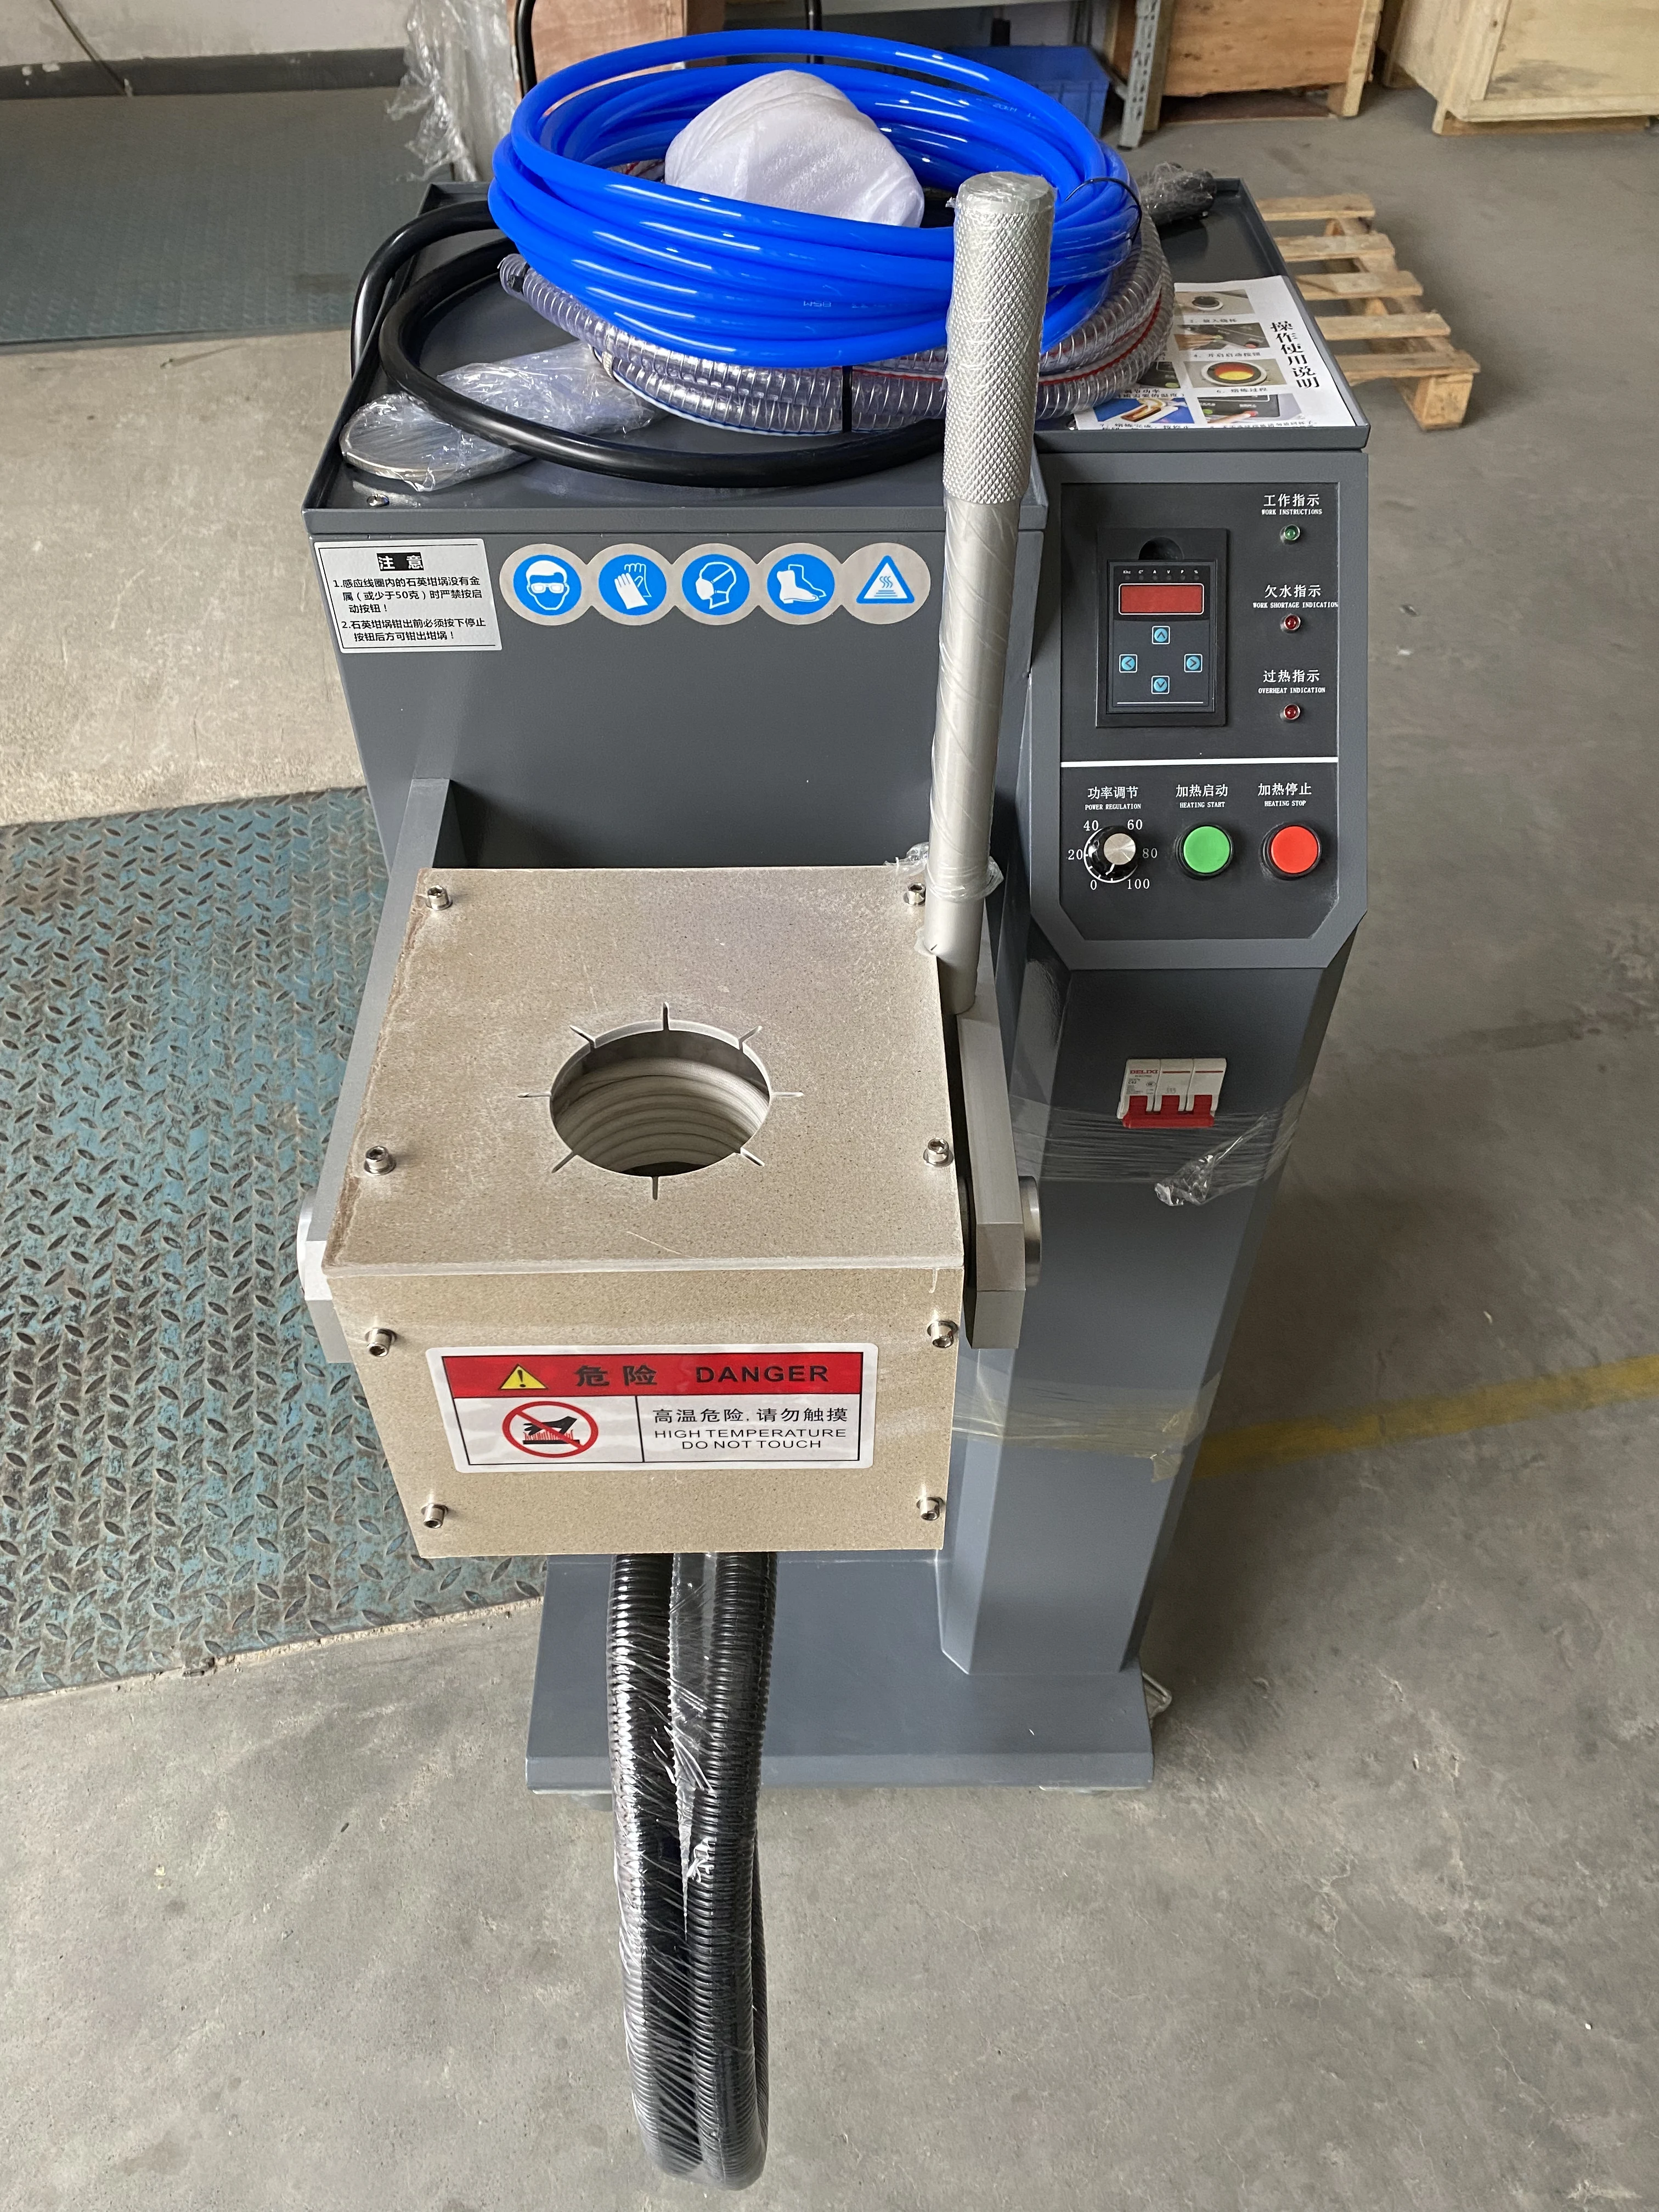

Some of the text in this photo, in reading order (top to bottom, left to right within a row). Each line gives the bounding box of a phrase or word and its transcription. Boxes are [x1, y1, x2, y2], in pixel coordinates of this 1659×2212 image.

[1270, 320, 1320, 388] 操作使用说明
[1263, 493, 1320, 507] 工作指示
[1265, 584, 1321, 598] 欠水指示
[1263, 669, 1320, 683] 过热指示
[1087, 786, 1138, 799] 功率调节
[1176, 783, 1228, 798] 加热启动
[1257, 782, 1312, 796] 加热停止
[1083, 820, 1099, 831] 40
[1127, 819, 1143, 830] 60
[1068, 849, 1083, 860] 20
[1142, 848, 1158, 859] 80
[1090, 879, 1097, 890] 0
[1127, 878, 1150, 889] 100
[574, 1364, 829, 1386] 危险 DANGER
[655, 1429, 847, 1438] HIGH TEMPERATURE
[682, 1440, 821, 1449] DO NOT TOUCH
